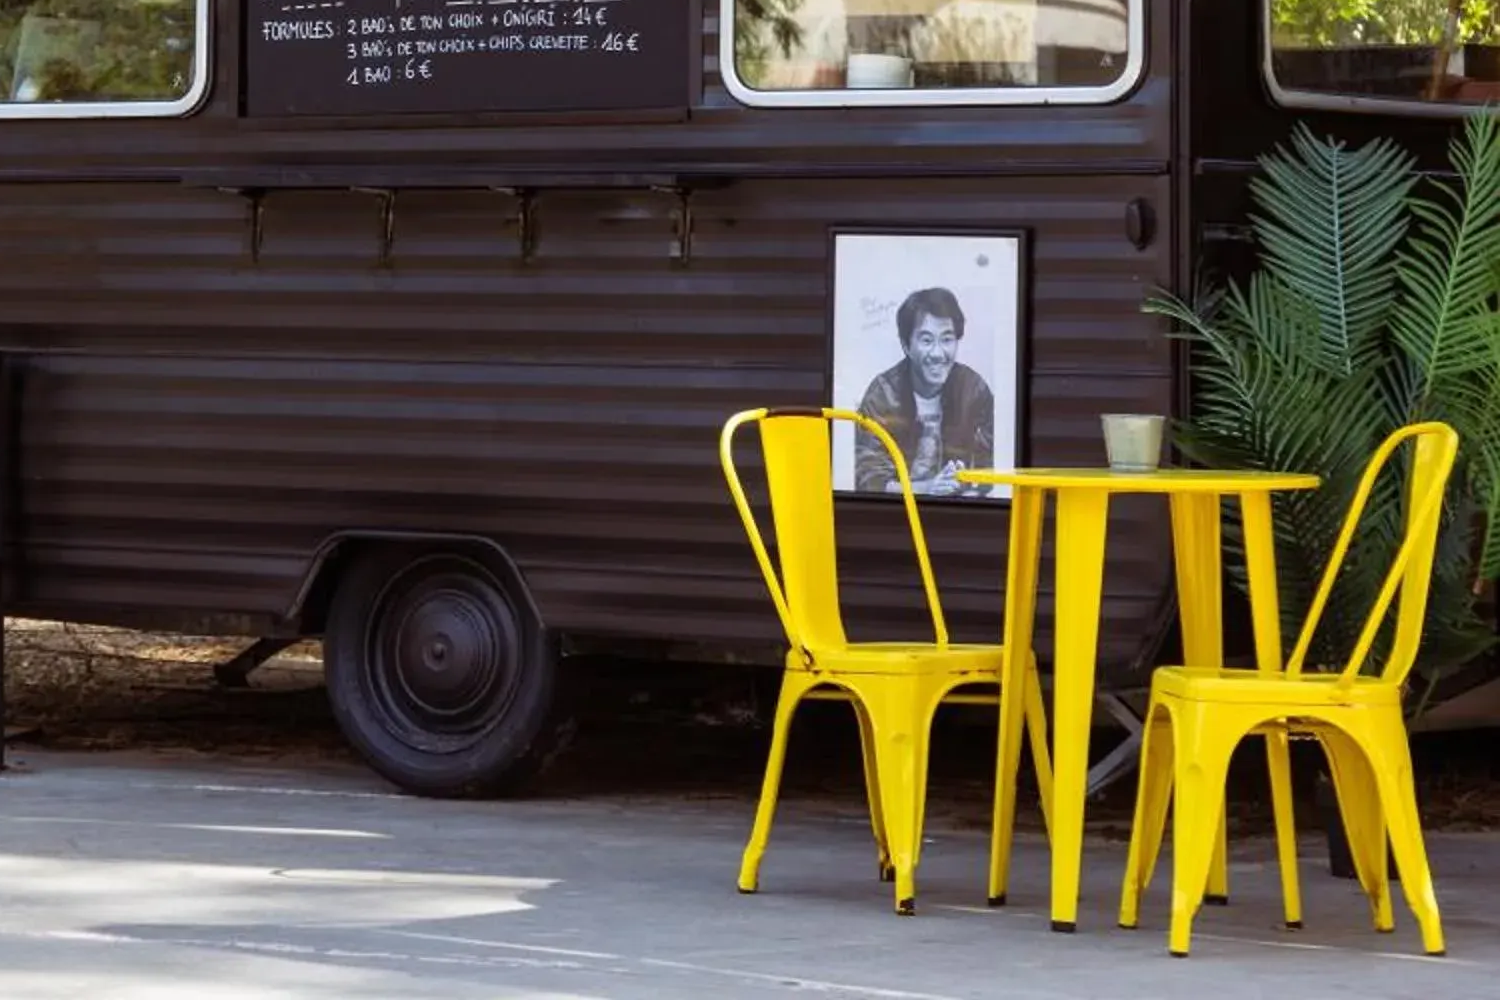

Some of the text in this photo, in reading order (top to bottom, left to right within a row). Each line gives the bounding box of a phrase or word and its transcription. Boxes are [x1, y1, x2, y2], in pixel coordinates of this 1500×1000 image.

[347, 19, 358, 35] 2
[400, 15, 416, 31] DE
[420, 15, 443, 31] TON
[347, 42, 358, 59] 3
[397, 40, 413, 56] DE
[488, 34, 526, 50] CHIPS
[528, 34, 589, 50] CREVETTE
